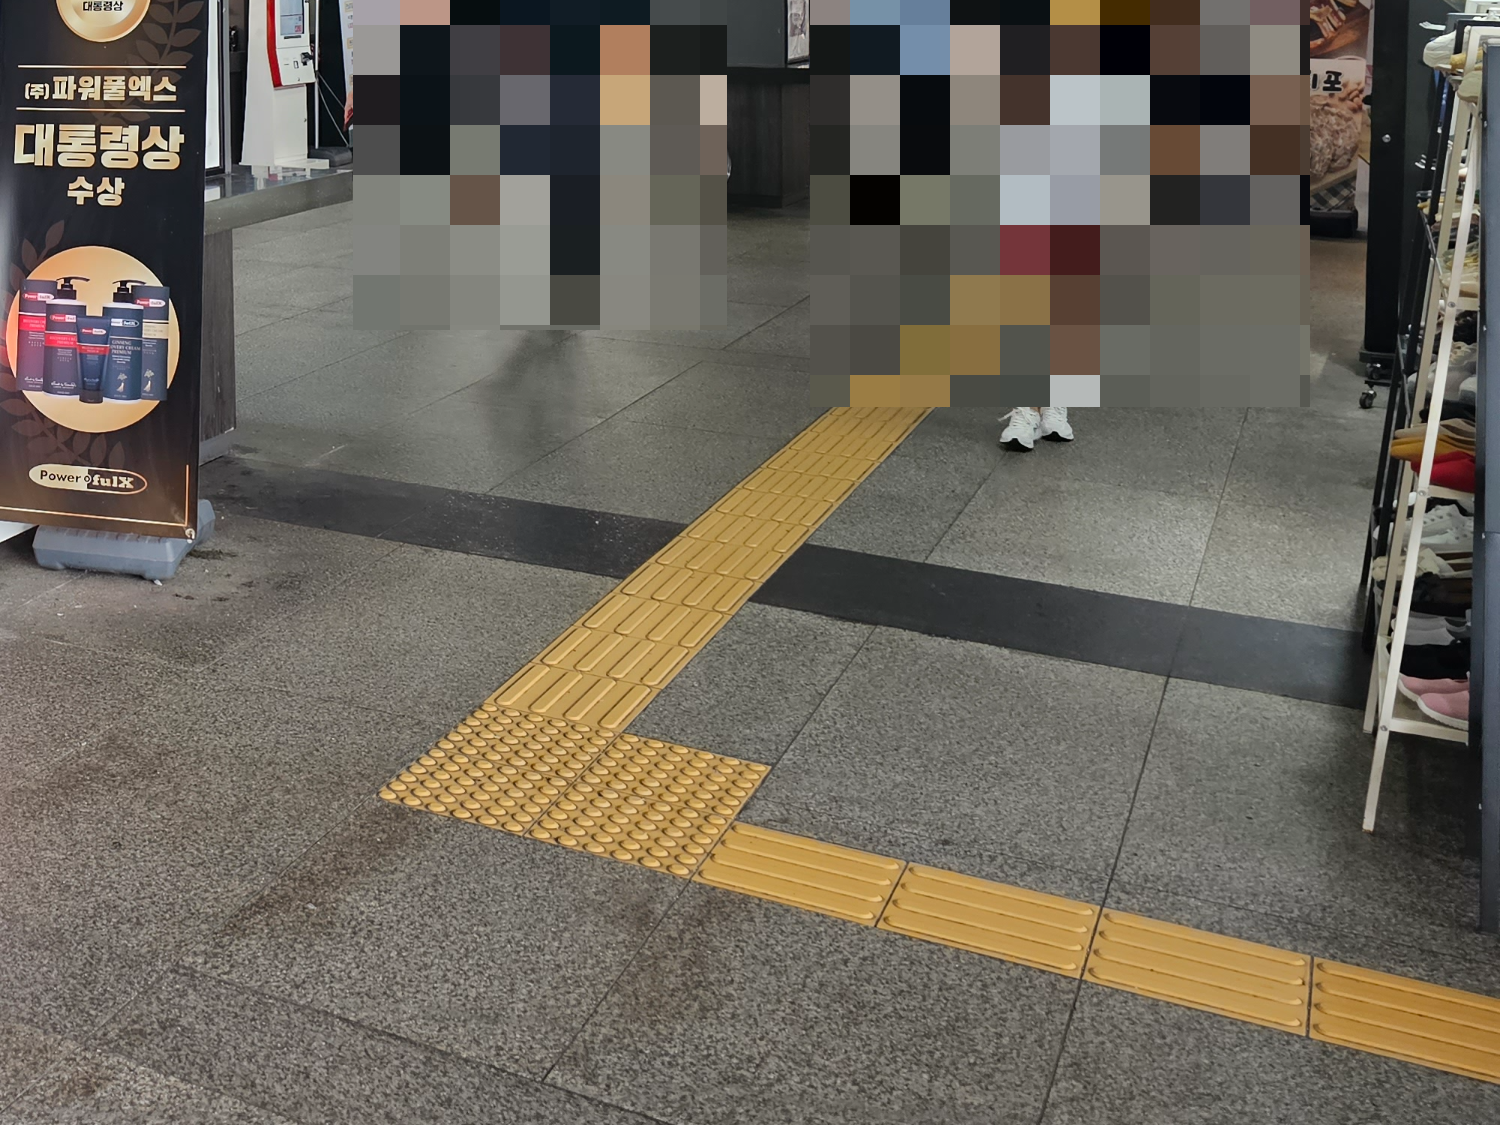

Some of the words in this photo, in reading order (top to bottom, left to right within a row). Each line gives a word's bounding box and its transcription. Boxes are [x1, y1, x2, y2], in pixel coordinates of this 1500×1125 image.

[82, 0, 124, 12] 대통령상
[13, 123, 185, 170] 대통령상
[67, 176, 125, 207] 수상
